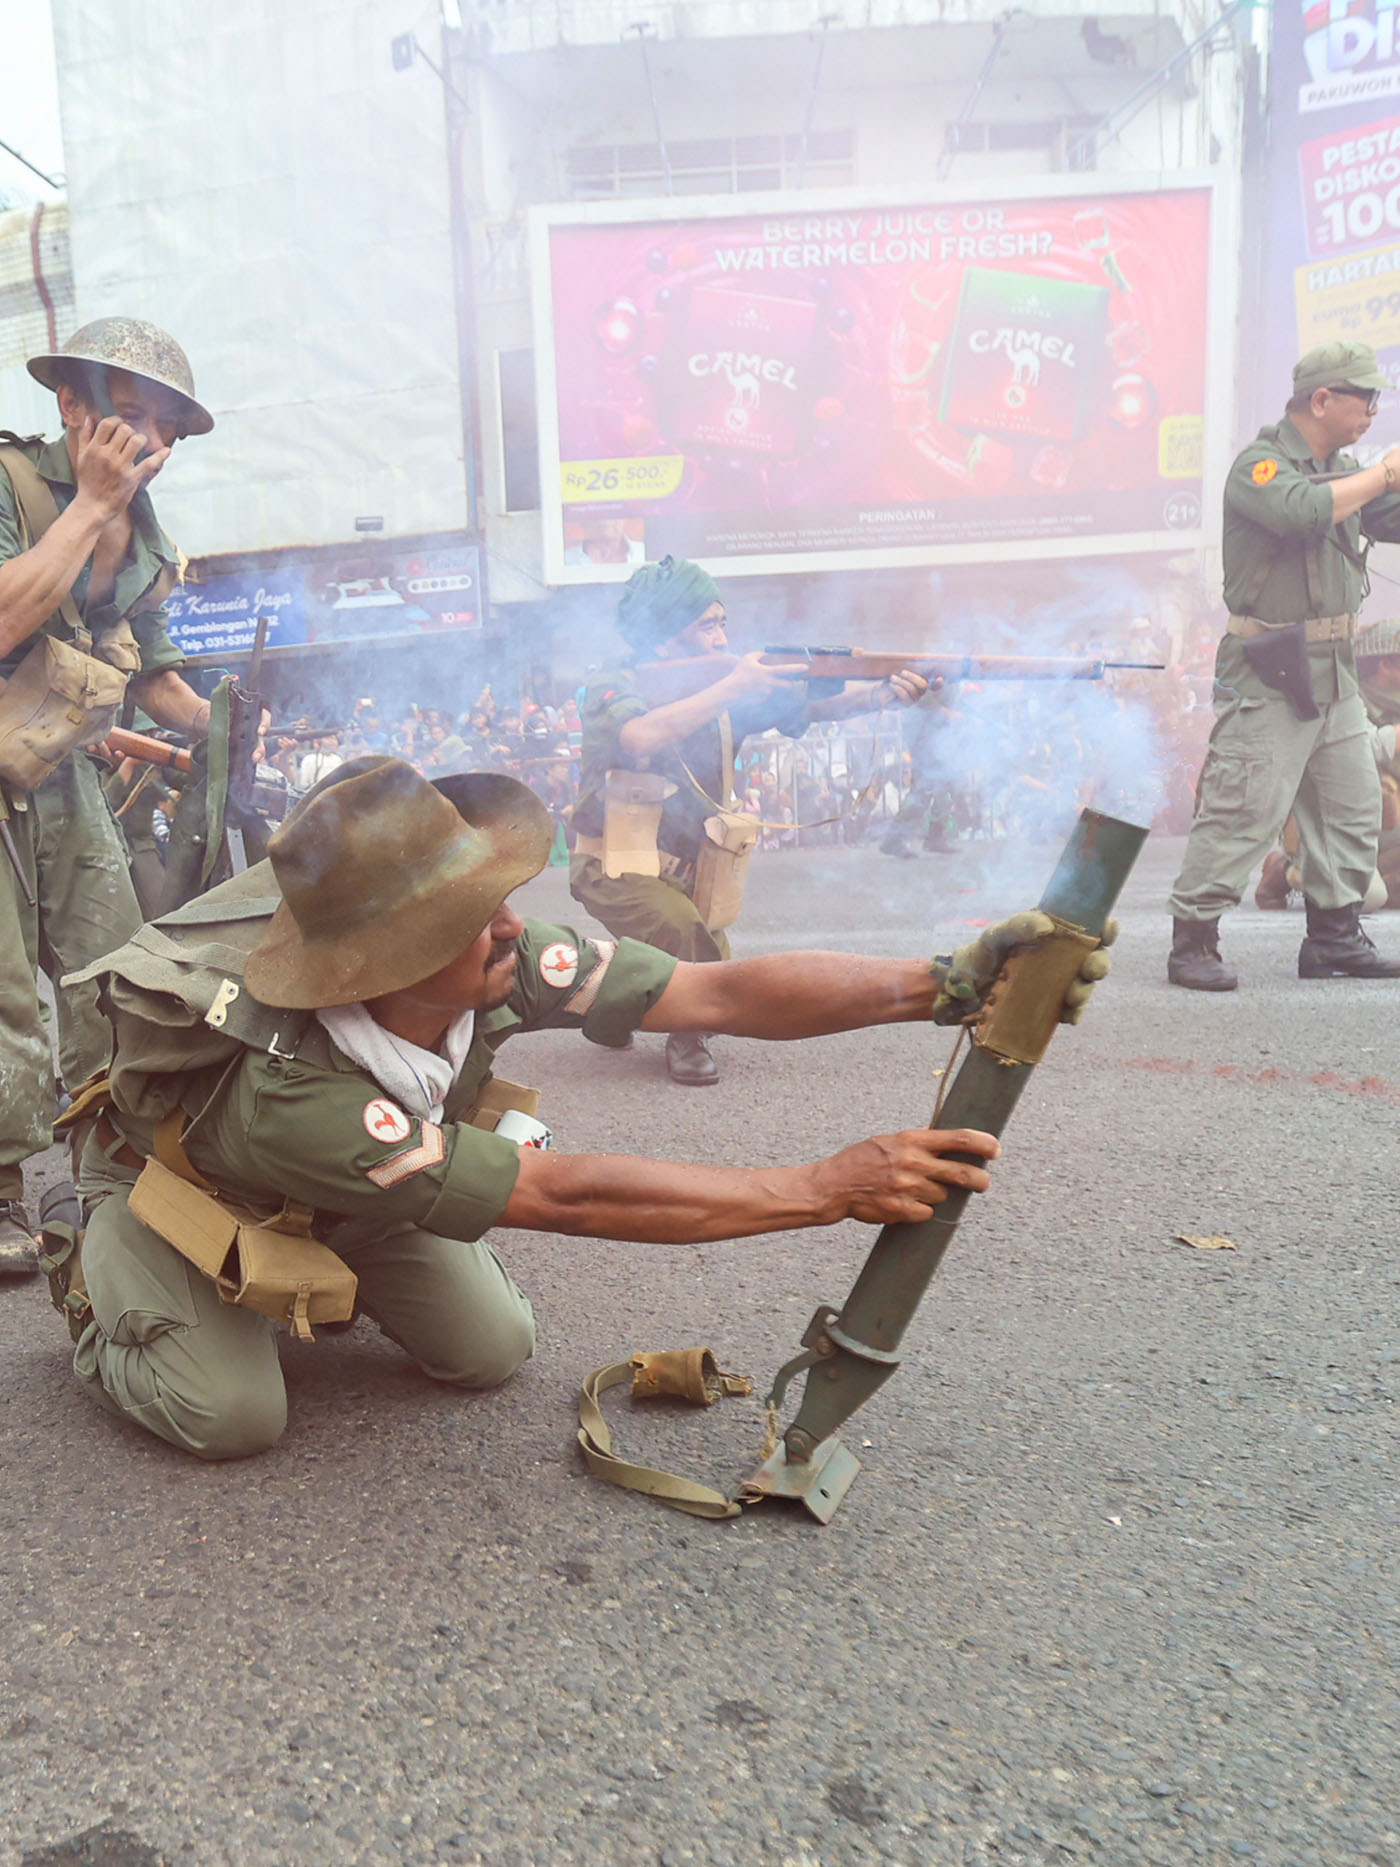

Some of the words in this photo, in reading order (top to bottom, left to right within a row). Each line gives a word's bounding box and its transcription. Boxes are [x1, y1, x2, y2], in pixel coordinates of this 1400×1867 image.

[1328, 10, 1400, 71] DI
[763, 215, 863, 243] BERRY
[871, 211, 952, 237] JUICE
[962, 207, 1007, 232] OR
[715, 239, 931, 271] WATERMELON
[941, 231, 1054, 259] FRESH?
[968, 327, 1076, 368] CAMEL
[688, 351, 799, 391] CAMEL
[858, 508, 937, 524] PERINGATAN
[185, 595, 250, 616] Karunia
[253, 588, 292, 614] Jaya
